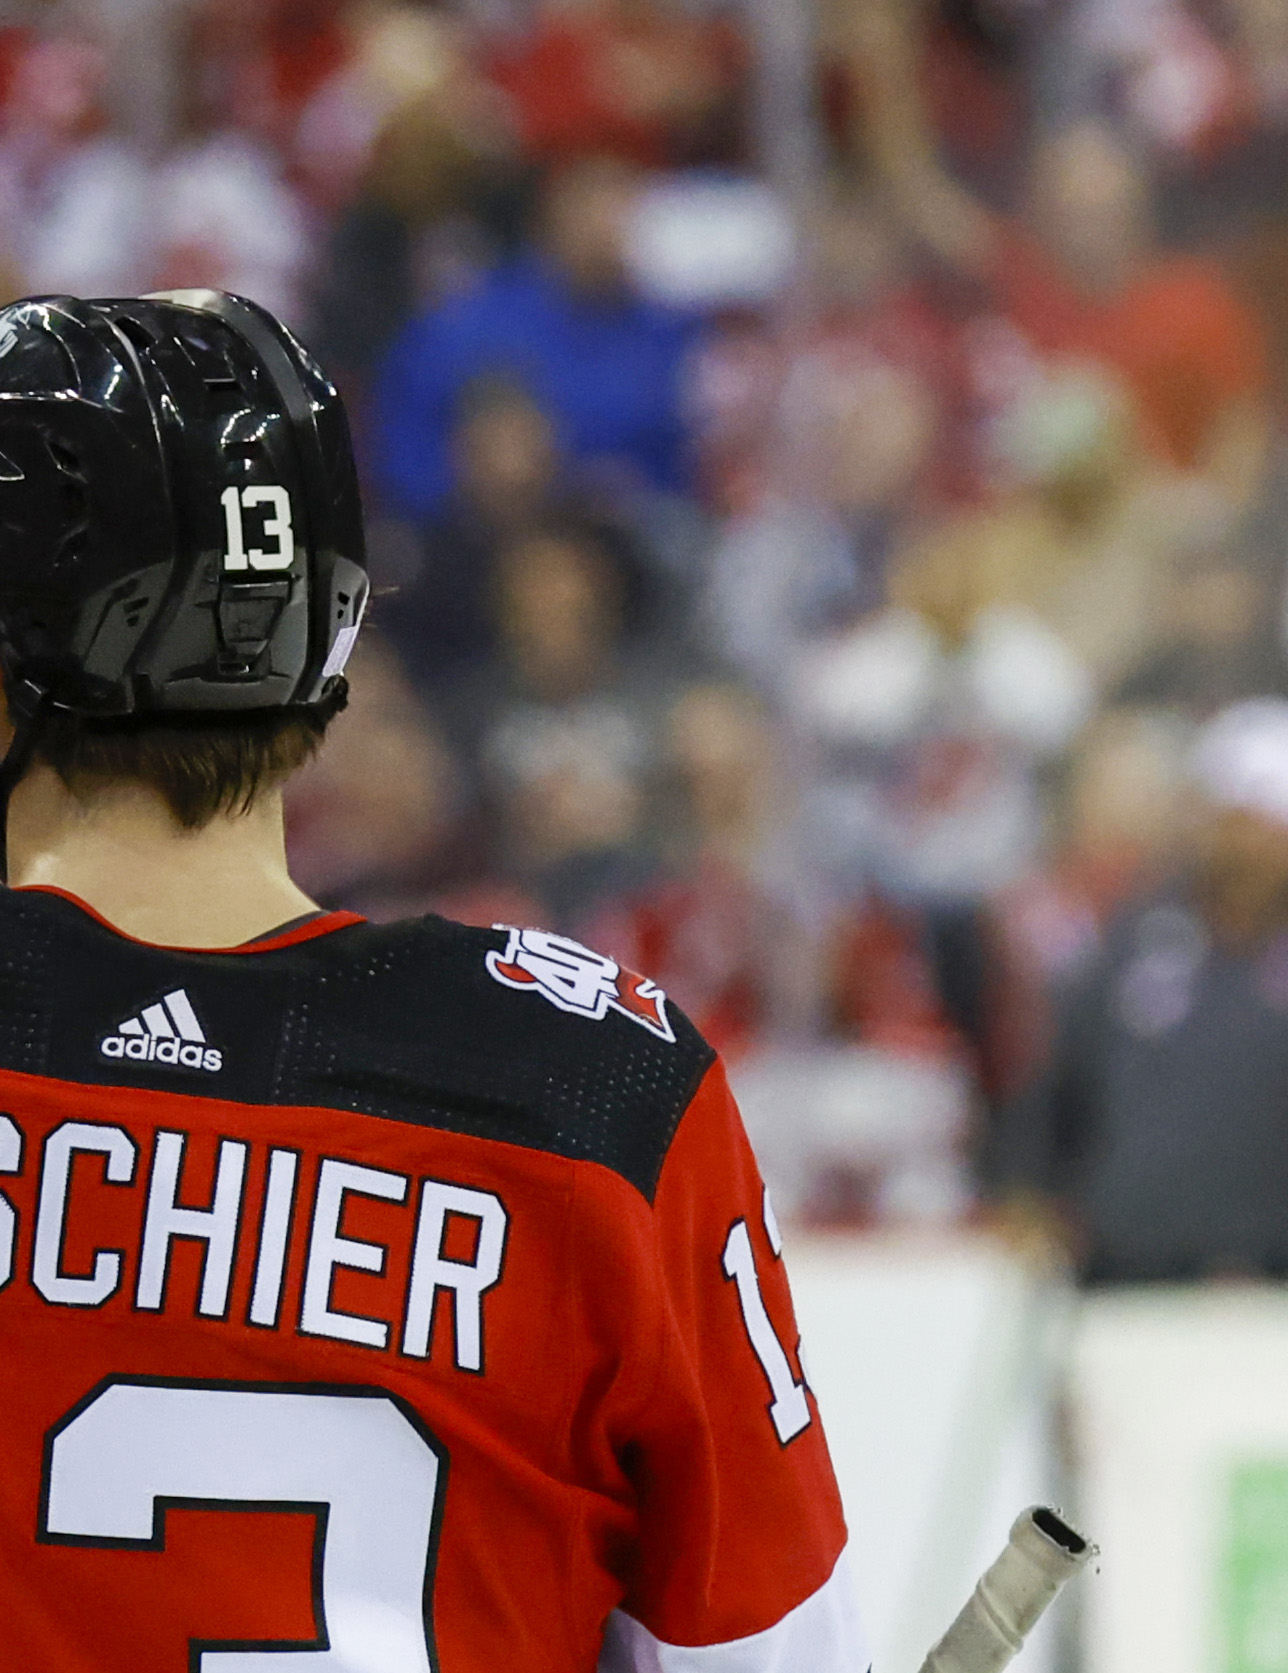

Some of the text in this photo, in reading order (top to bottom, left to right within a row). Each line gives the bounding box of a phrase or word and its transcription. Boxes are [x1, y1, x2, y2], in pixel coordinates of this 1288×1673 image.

[221, 485, 294, 570] 13
[101, 1033, 223, 1072] adidas
[721, 1182, 814, 1448] 1
